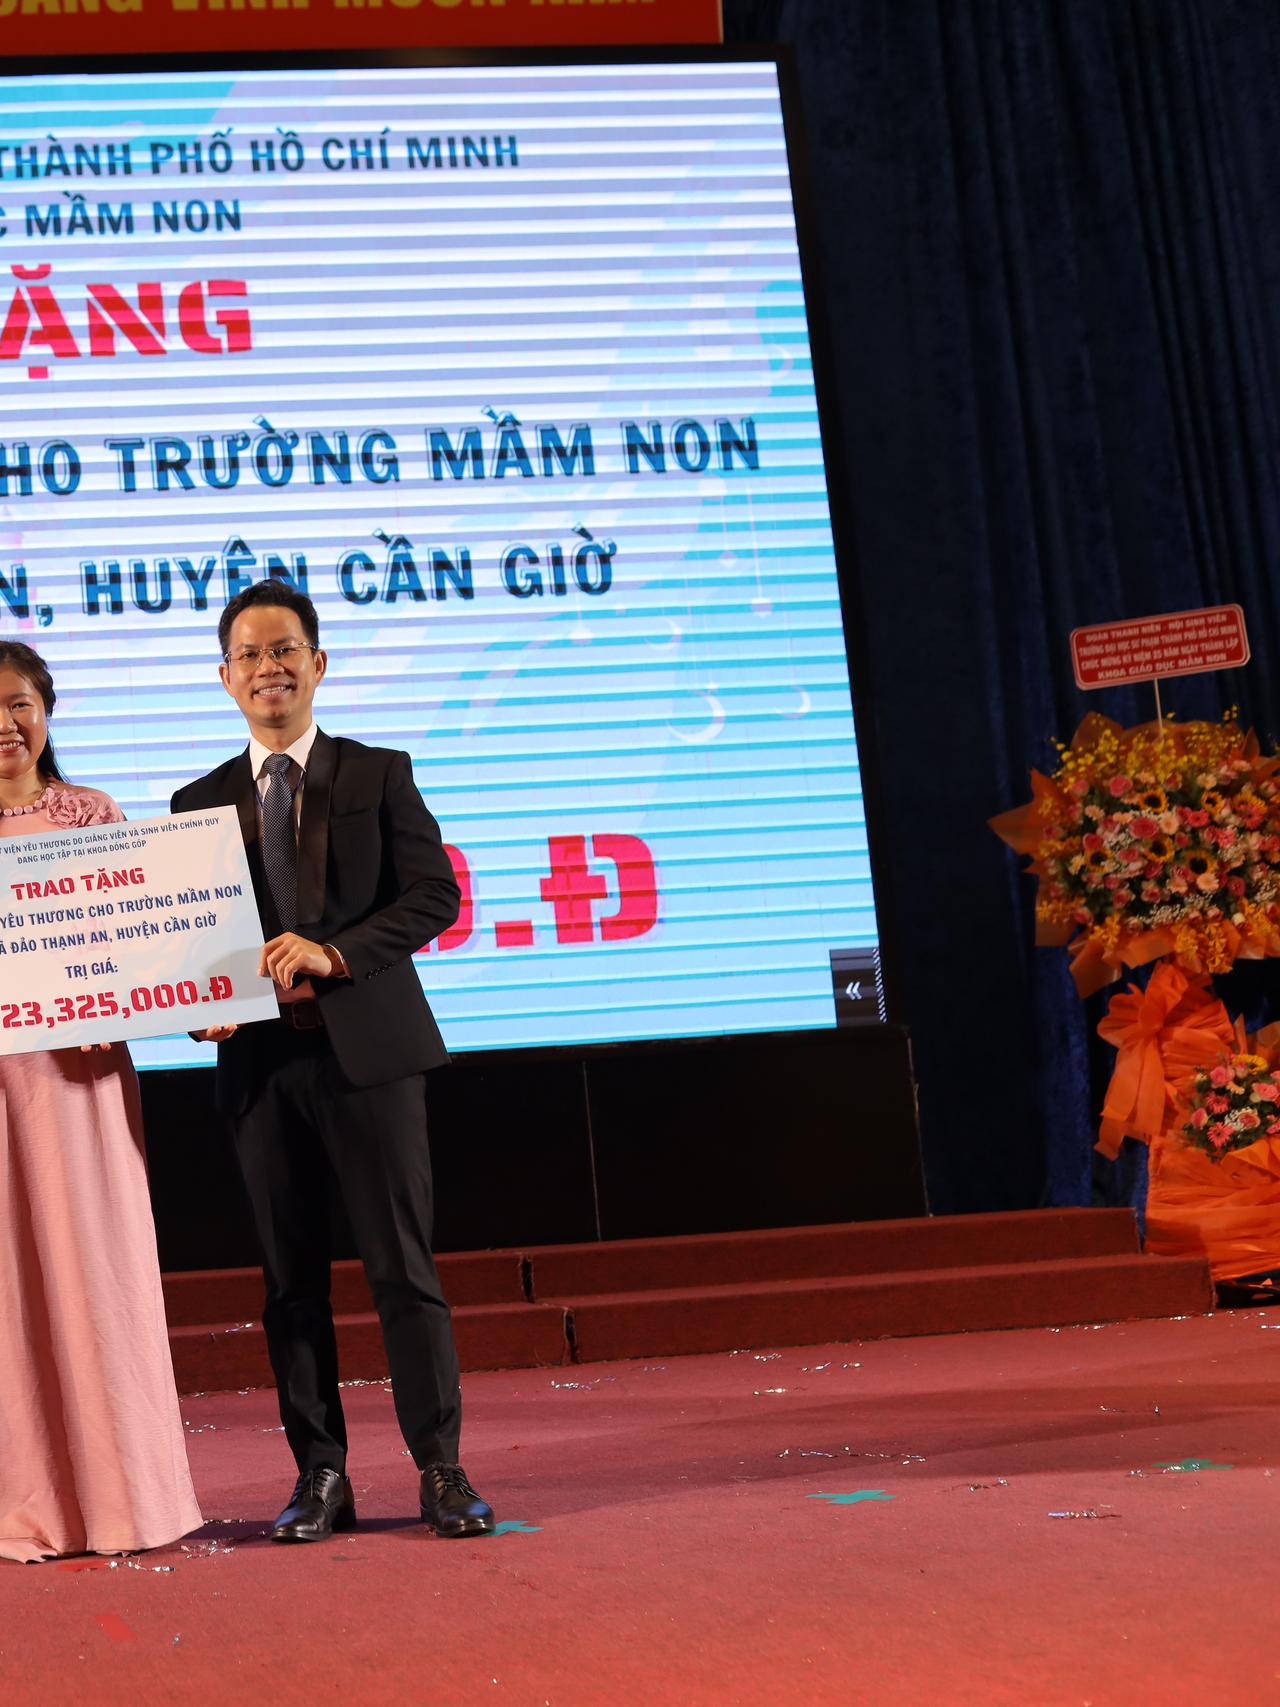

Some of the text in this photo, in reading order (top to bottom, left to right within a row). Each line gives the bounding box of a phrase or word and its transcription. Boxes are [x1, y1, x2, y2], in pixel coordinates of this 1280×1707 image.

[150, 126, 234, 174] PHỐ
[250, 126, 305, 172] HỒ
[321, 126, 392, 171] CHÍ
[406, 135, 519, 170] MINH
[24, 191, 135, 238] MẦM
[153, 198, 242, 234] NON
[104, 413, 401, 493] TRƯỜNG
[424, 404, 596, 481] MẦM
[620, 417, 761, 474] NON
[336, 527, 475, 605] CẦN
[500, 523, 617, 599] GIỜ
[1098, 668, 1126, 679] KHOA
[1206, 653, 1227, 663] NON
[4, 844, 22, 855] VIỆN
[22, 842, 38, 853] YÊU
[39, 838, 71, 850] THƯƠNG
[72, 837, 83, 845] DO
[84, 832, 108, 844] GIẢNG
[109, 829, 127, 840] VIÊN
[128, 826, 140, 837] VÀ
[141, 826, 159, 836] SINH
[160, 823, 178, 833] VIÊN
[180, 819, 203, 830] CHÍNH
[204, 817, 220, 826] QUY
[17, 840, 147, 865] ĐANG HỌC TẬP TẠI KHOA ĐÓNG GÓP
[10, 867, 145, 900] TRAO TẶNG
[0, 912, 24, 929] YÊU
[28, 908, 84, 926] THƯƠNG
[88, 903, 114, 918] CHO
[117, 894, 173, 914] TRƯỜNG
[177, 887, 210, 905] MẦM
[214, 884, 243, 899] NON
[10, 937, 37, 954] ĐẢO
[40, 932, 86, 951] THẠNH
[90, 930, 113, 944] AN,
[116, 920, 160, 940] HUYỆN
[164, 916, 190, 933] CẦN
[194, 910, 217, 928] GIỜ
[65, 957, 119, 980] TRỊ GIÁ:
[0, 975, 234, 1029] 23,325,000.Đ
